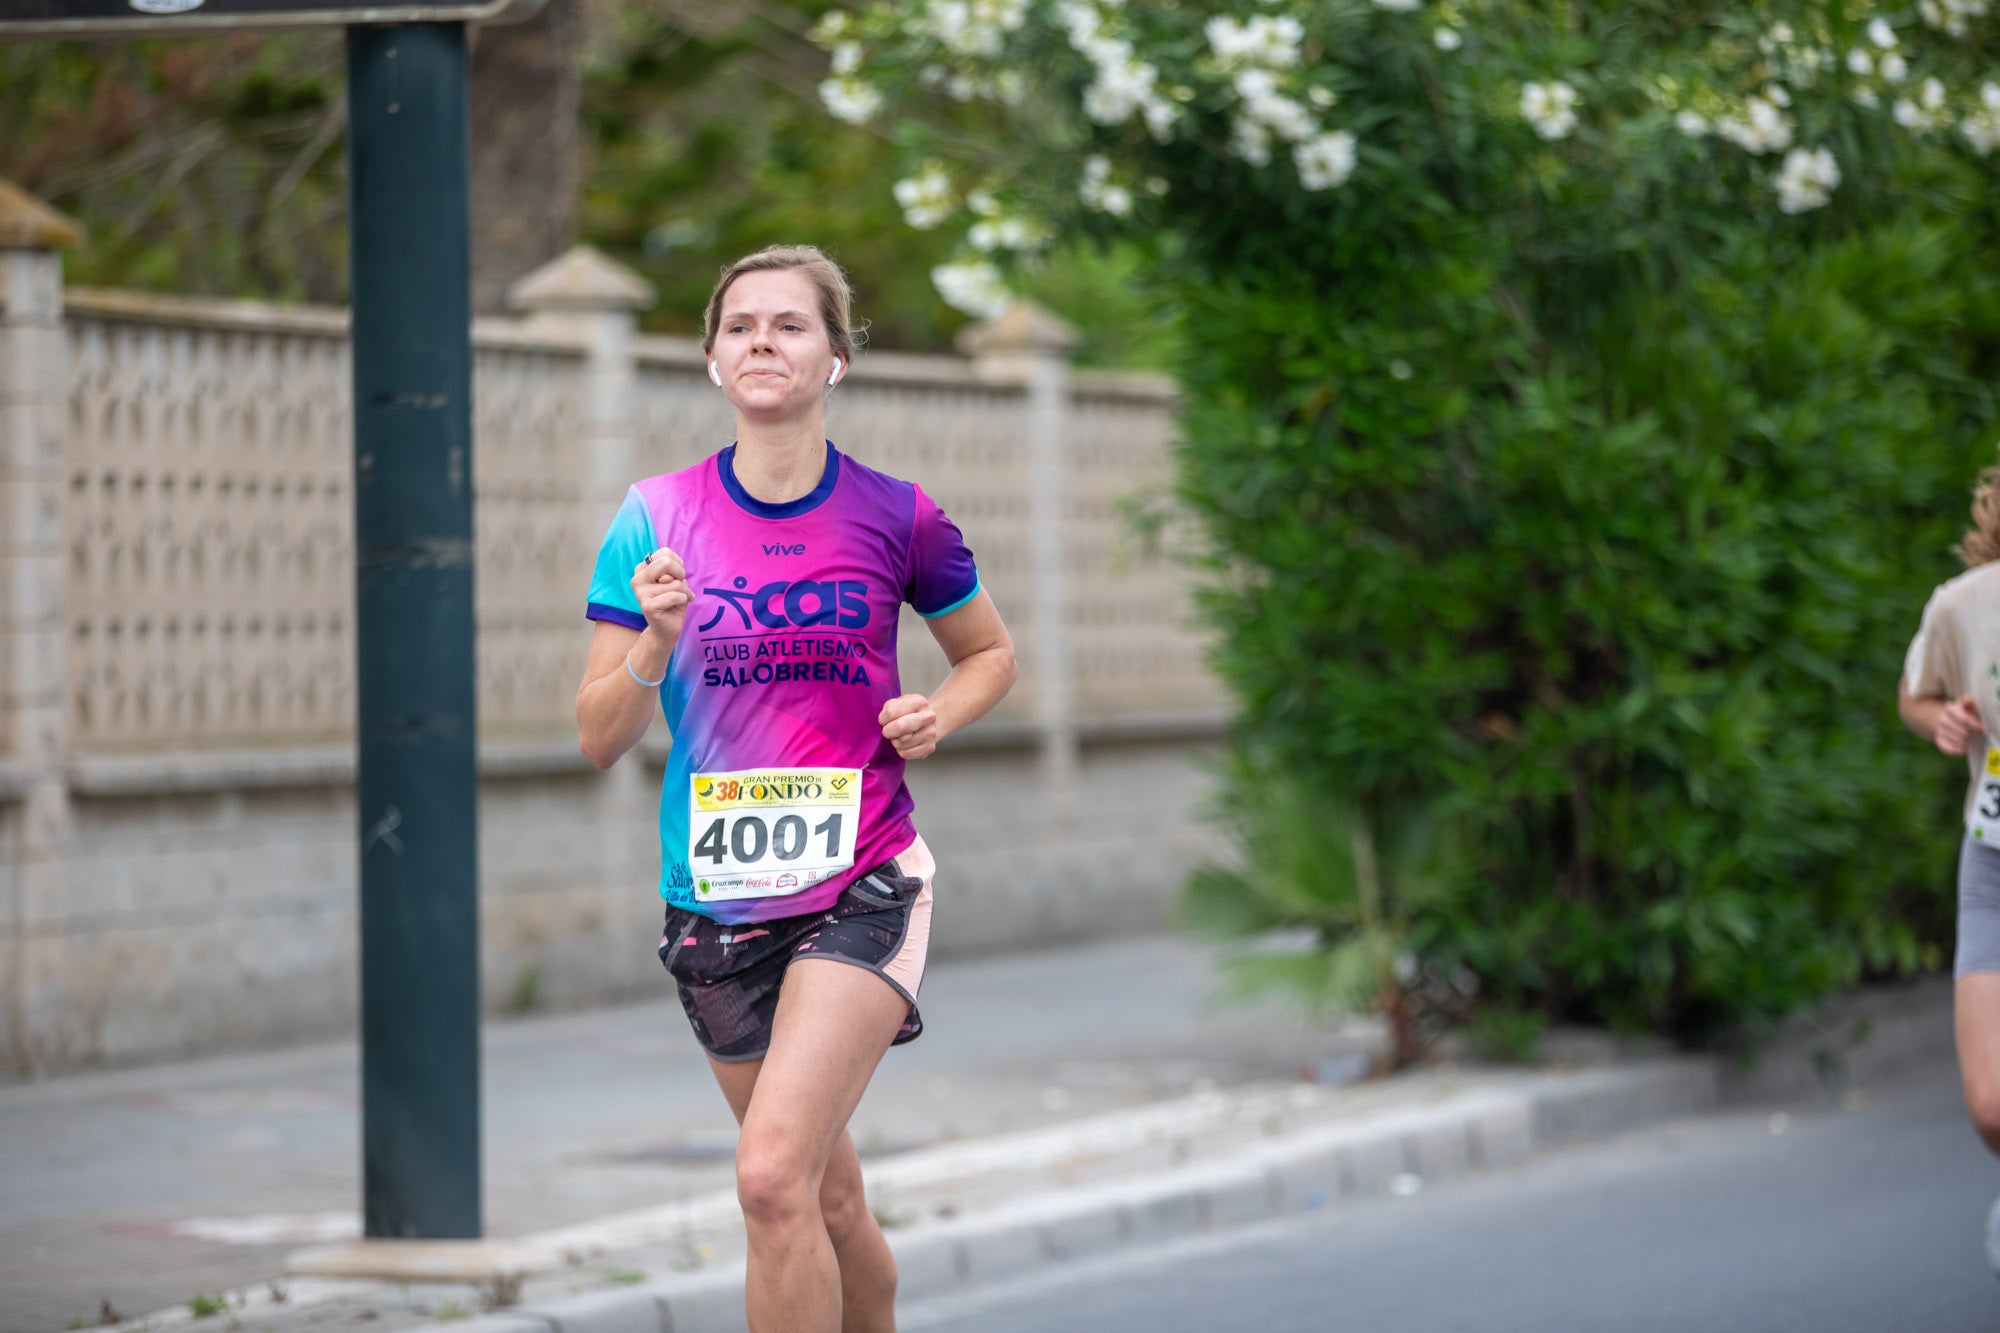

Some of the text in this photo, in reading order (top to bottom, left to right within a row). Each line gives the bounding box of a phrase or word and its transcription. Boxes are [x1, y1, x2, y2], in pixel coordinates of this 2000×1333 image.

[762, 542, 806, 556] vive
[704, 639, 867, 662] CLUB ATLETISMO
[703, 658, 871, 688] SALOBREÑA
[743, 776, 771, 784] GRAN
[774, 775, 814, 783] PREMIO
[715, 780, 739, 801] 38
[694, 813, 842, 865] 4001
[711, 879, 744, 887] Cruzcampo
